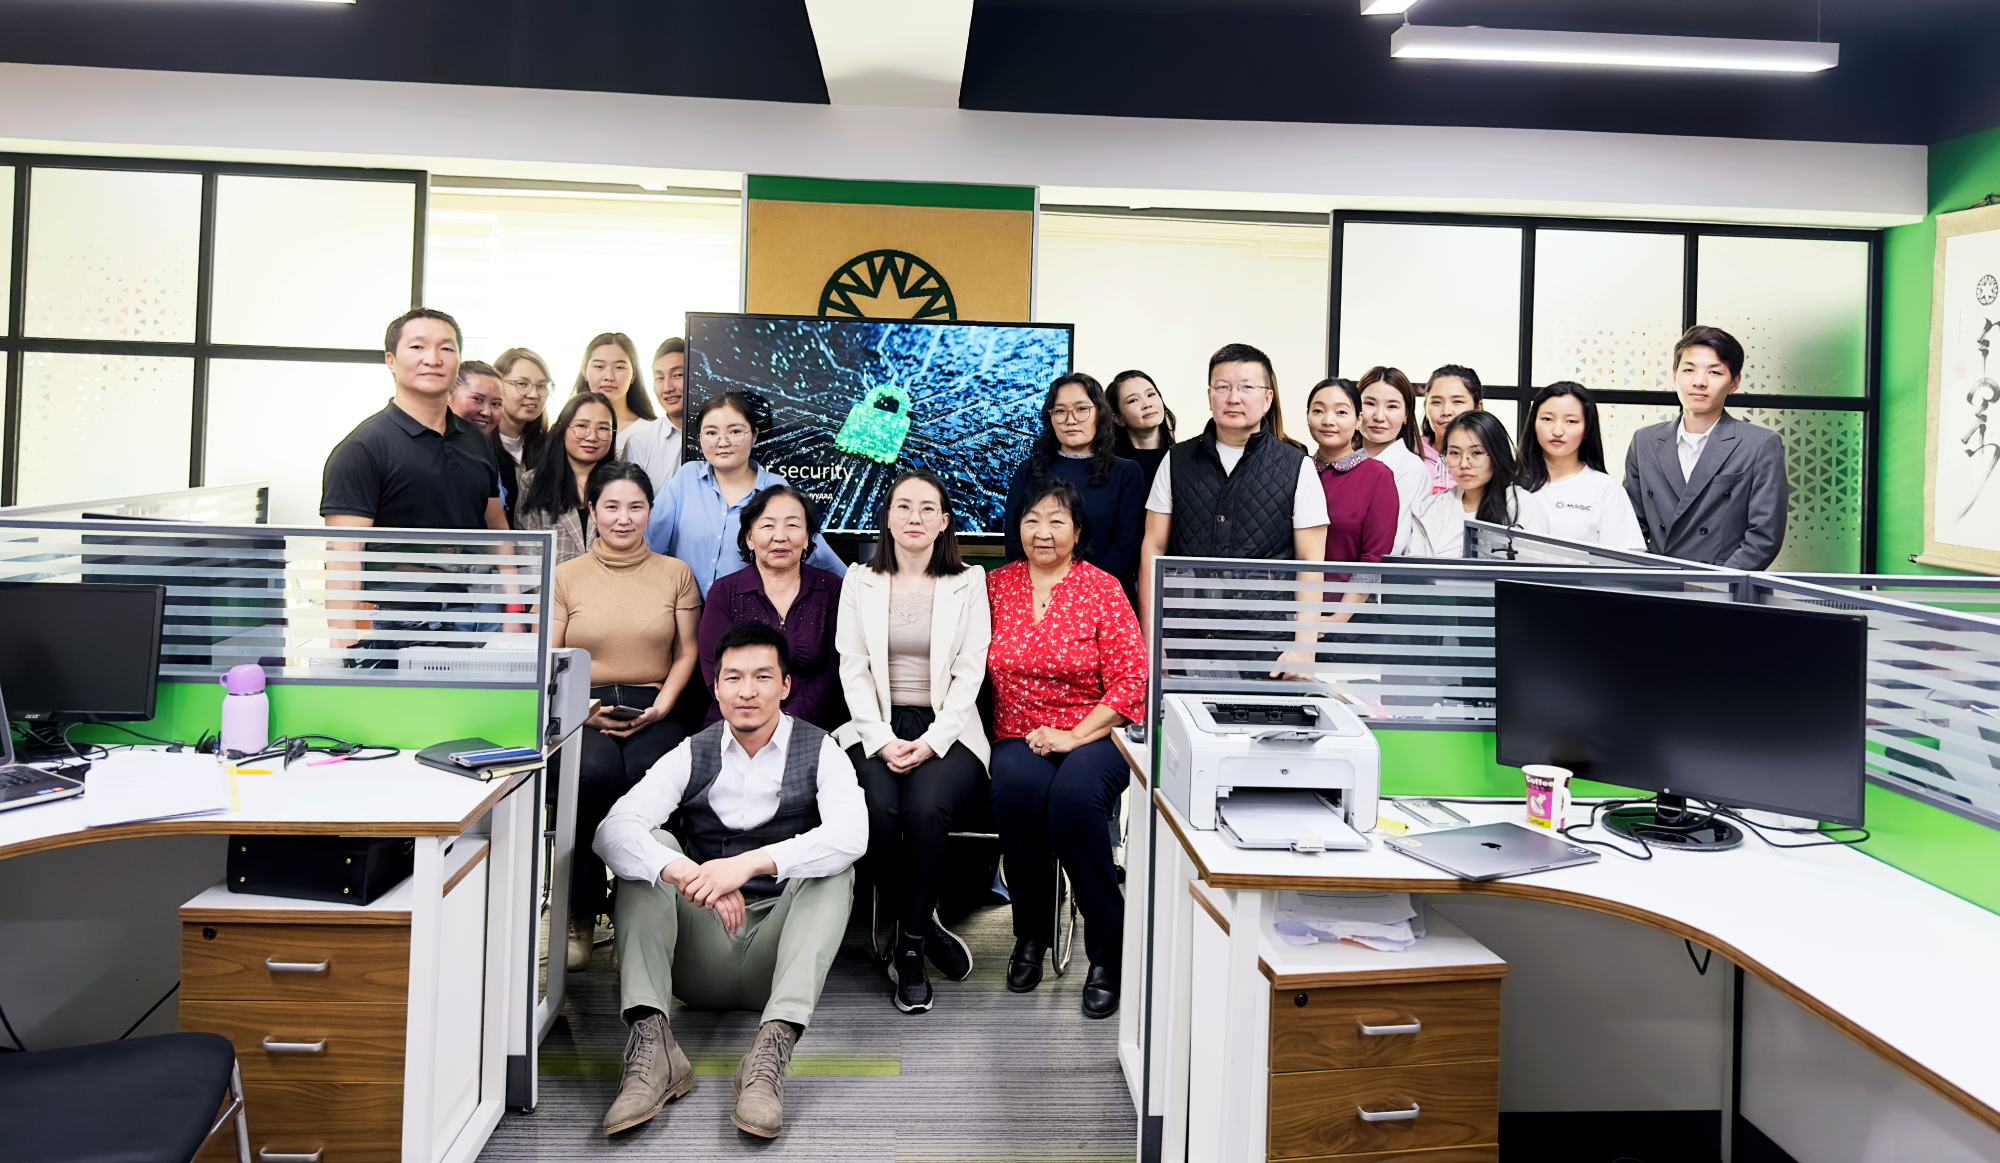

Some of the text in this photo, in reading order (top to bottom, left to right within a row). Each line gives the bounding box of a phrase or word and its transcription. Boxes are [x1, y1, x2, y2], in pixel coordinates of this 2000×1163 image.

[779, 463, 853, 483] security
[1566, 503, 1592, 511] MAGIC
[1526, 775, 1554, 787] Coffee
[1529, 816, 1545, 826] Coffee
